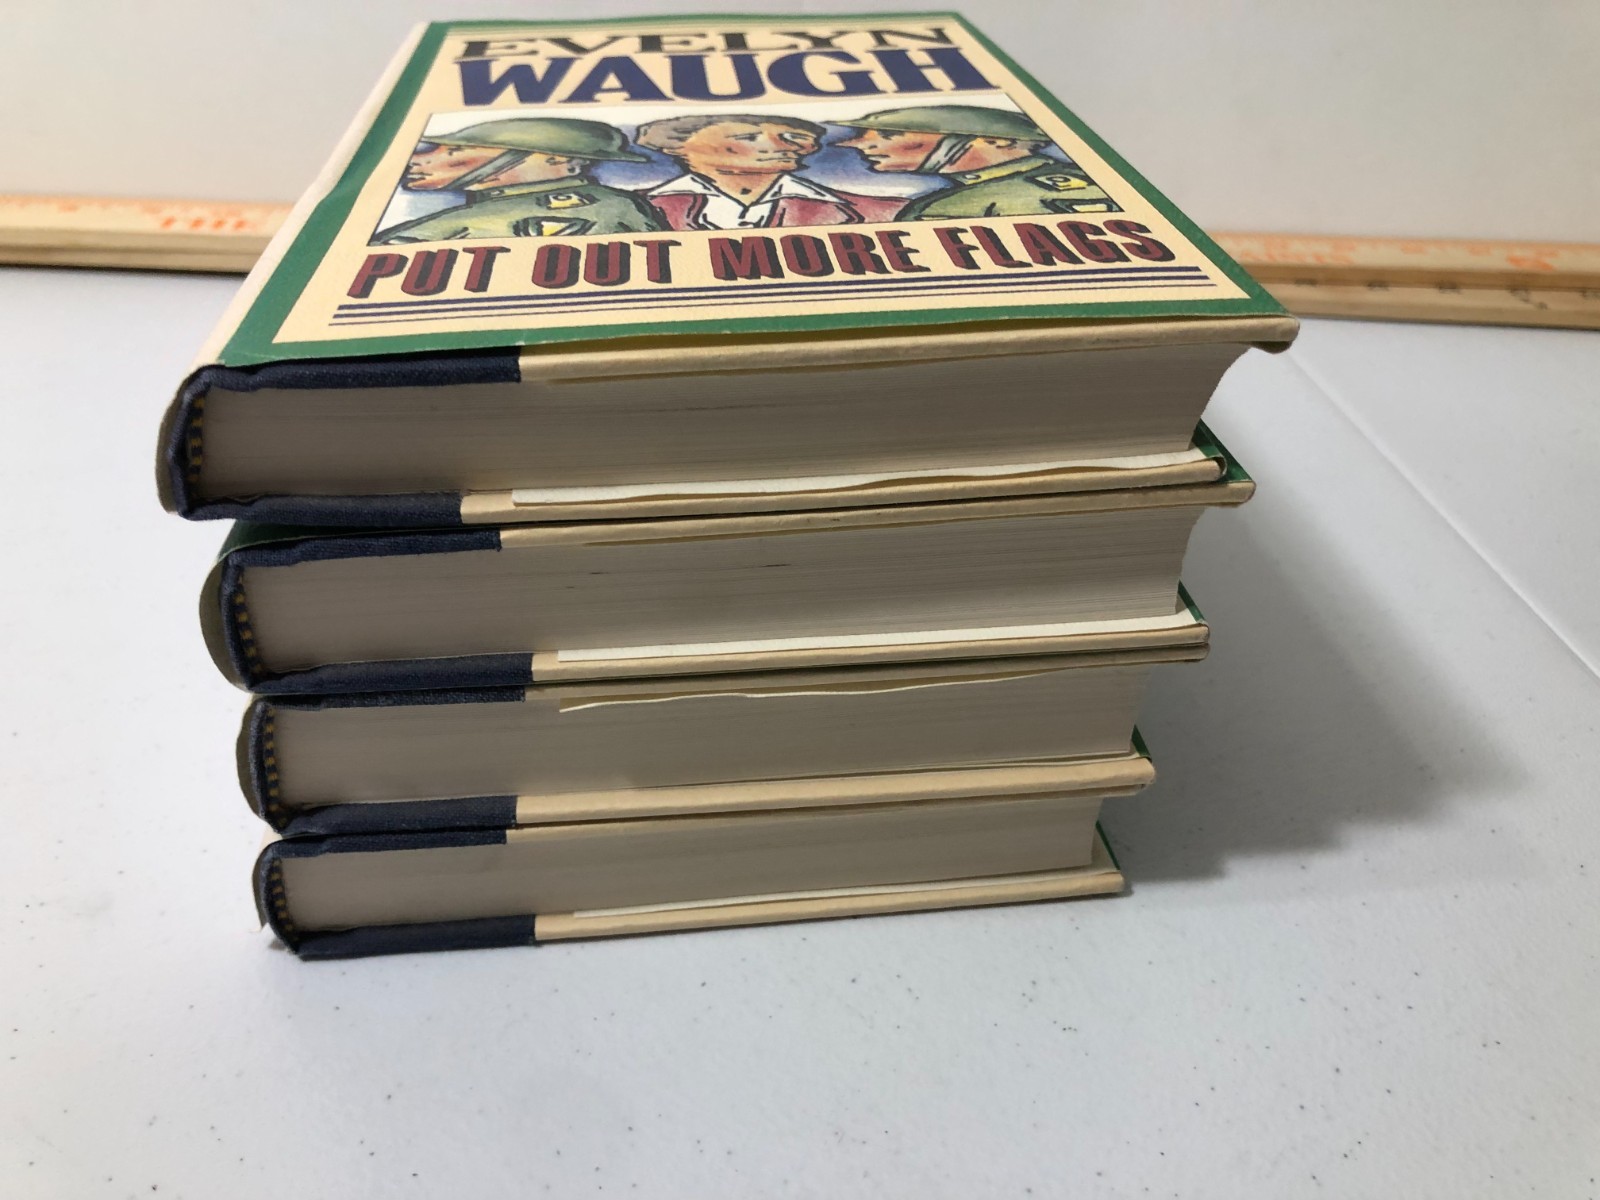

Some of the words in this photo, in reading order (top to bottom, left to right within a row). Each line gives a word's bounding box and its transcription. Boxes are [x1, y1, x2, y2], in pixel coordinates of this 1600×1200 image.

[457, 28, 957, 60] EVELYN
[456, 47, 1001, 106] WAUGH
[347, 246, 511, 299] PUT
[531, 239, 681, 289] OUT
[708, 230, 931, 281] MORE
[933, 219, 1176, 270] FLAGS
